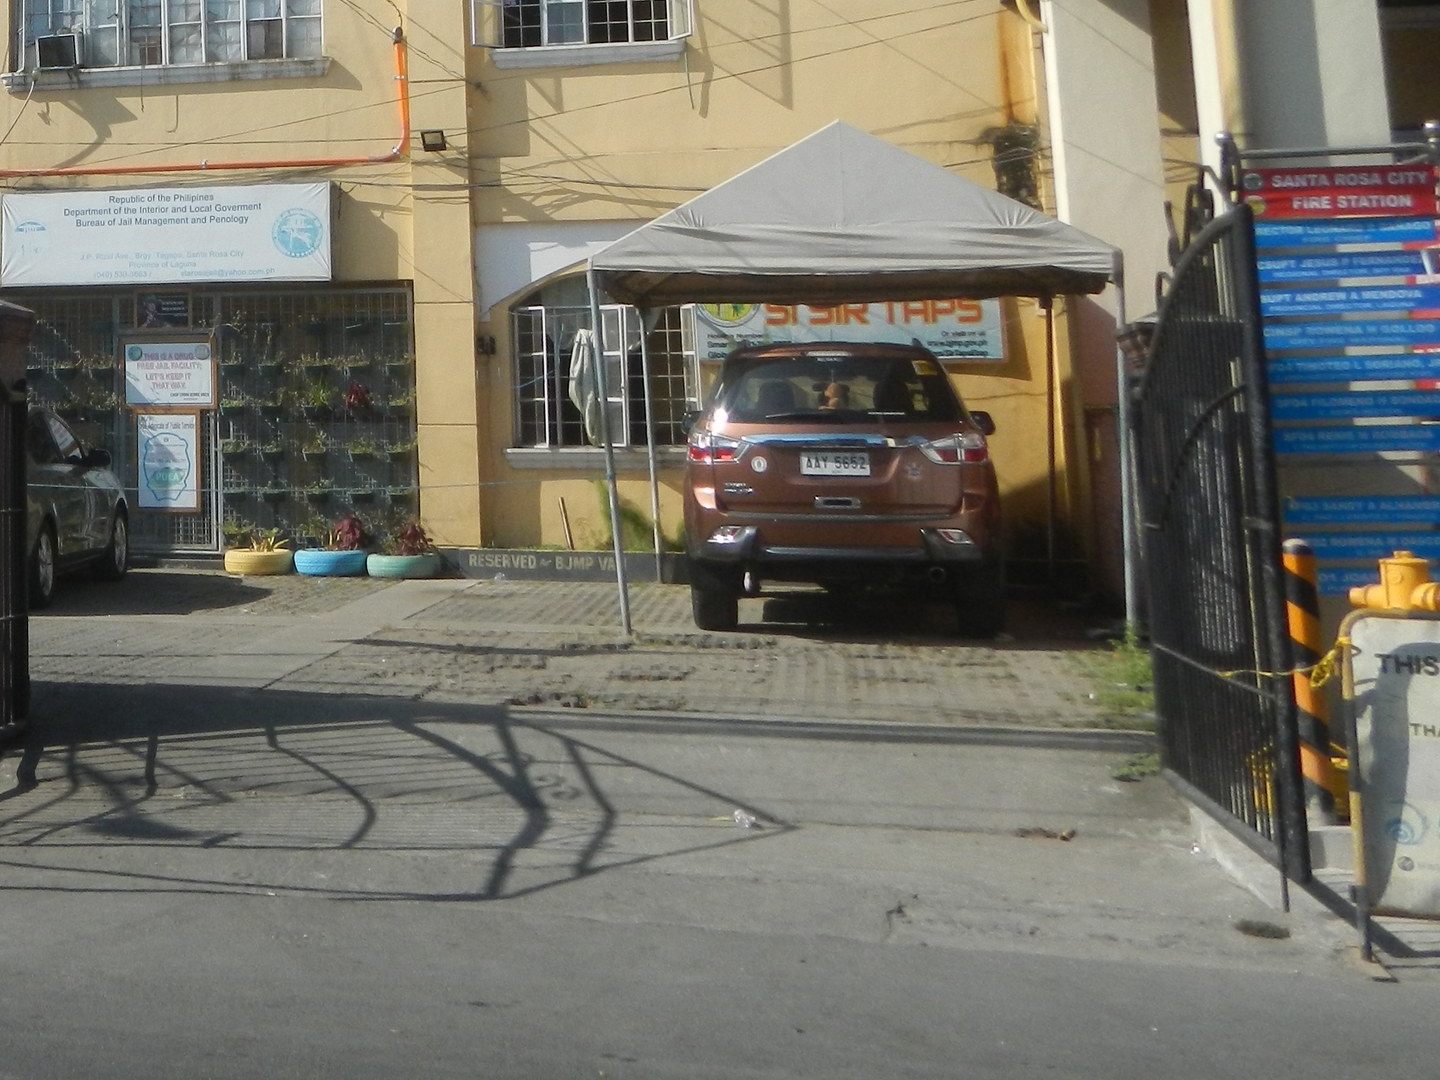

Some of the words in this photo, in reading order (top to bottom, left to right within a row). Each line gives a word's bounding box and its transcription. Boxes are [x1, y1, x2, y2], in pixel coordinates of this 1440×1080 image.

[1271, 173, 1330, 188] SANTA
[1334, 172, 1383, 186] ROSA
[1387, 170, 1428, 185] CITY
[109, 195, 145, 205] Republic
[147, 194, 156, 202] of
[157, 194, 171, 202] the
[1292, 196, 1332, 210] FIRE
[1337, 193, 1413, 209] STATION
[63, 207, 111, 217] Department
[113, 206, 122, 215] of
[124, 206, 137, 214] the
[139, 205, 169, 214] Interior
[171, 205, 187, 213] and
[189, 204, 212, 213] Local
[76, 218, 105, 227] Bureau
[107, 218, 116, 226] of
[118, 217, 133, 226] Jail
[134, 216, 189, 226] Management
[191, 215, 207, 224] and
[209, 214, 249, 224] Penology
[765, 303, 798, 326] SI
[808, 304, 869, 326] SIR
[144, 352, 159, 361] THIS
[137, 362, 155, 370] FREE
[165, 372, 184, 380] KEEP
[184, 372, 191, 380] IT
[152, 381, 169, 389] THAT
[805, 458, 829, 469] AAY
[834, 457, 867, 469] 5652
[468, 553, 537, 569] RESERVED
[554, 553, 594, 570] BJMP
[597, 556, 627, 571] VA
[1375, 653, 1440, 677] THIS
